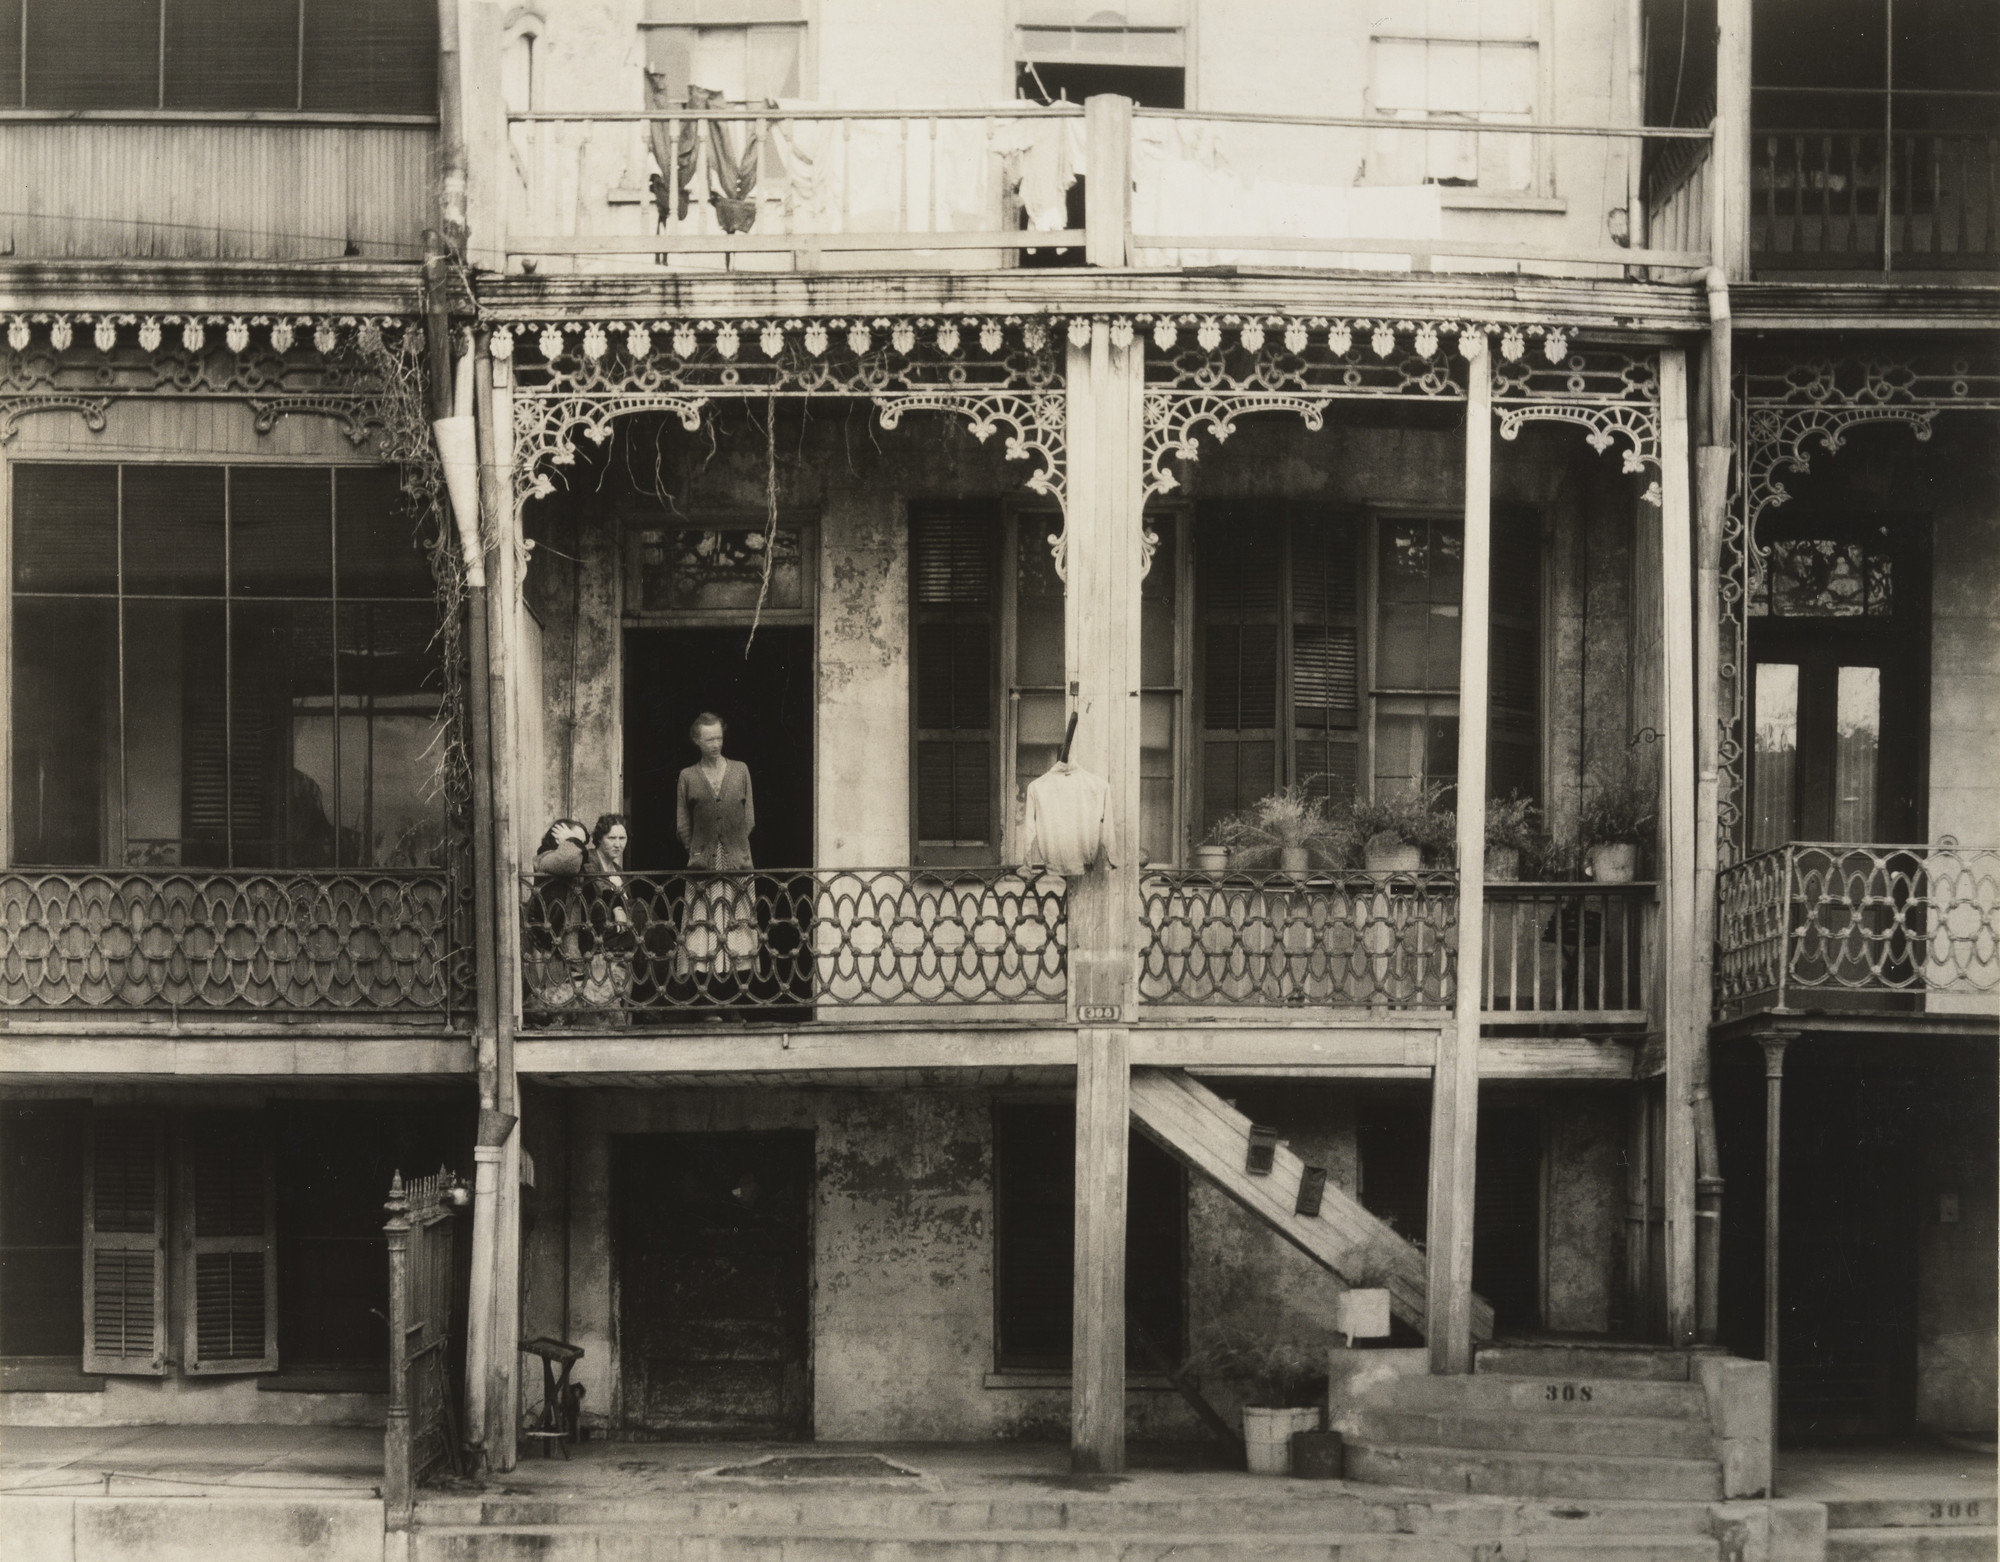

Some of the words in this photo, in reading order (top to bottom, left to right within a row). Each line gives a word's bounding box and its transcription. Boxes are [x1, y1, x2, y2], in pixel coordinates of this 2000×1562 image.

[1086, 1007, 1113, 1018] 308
[1545, 1384, 1593, 1402] 308
[1929, 1501, 1980, 1519] 306
